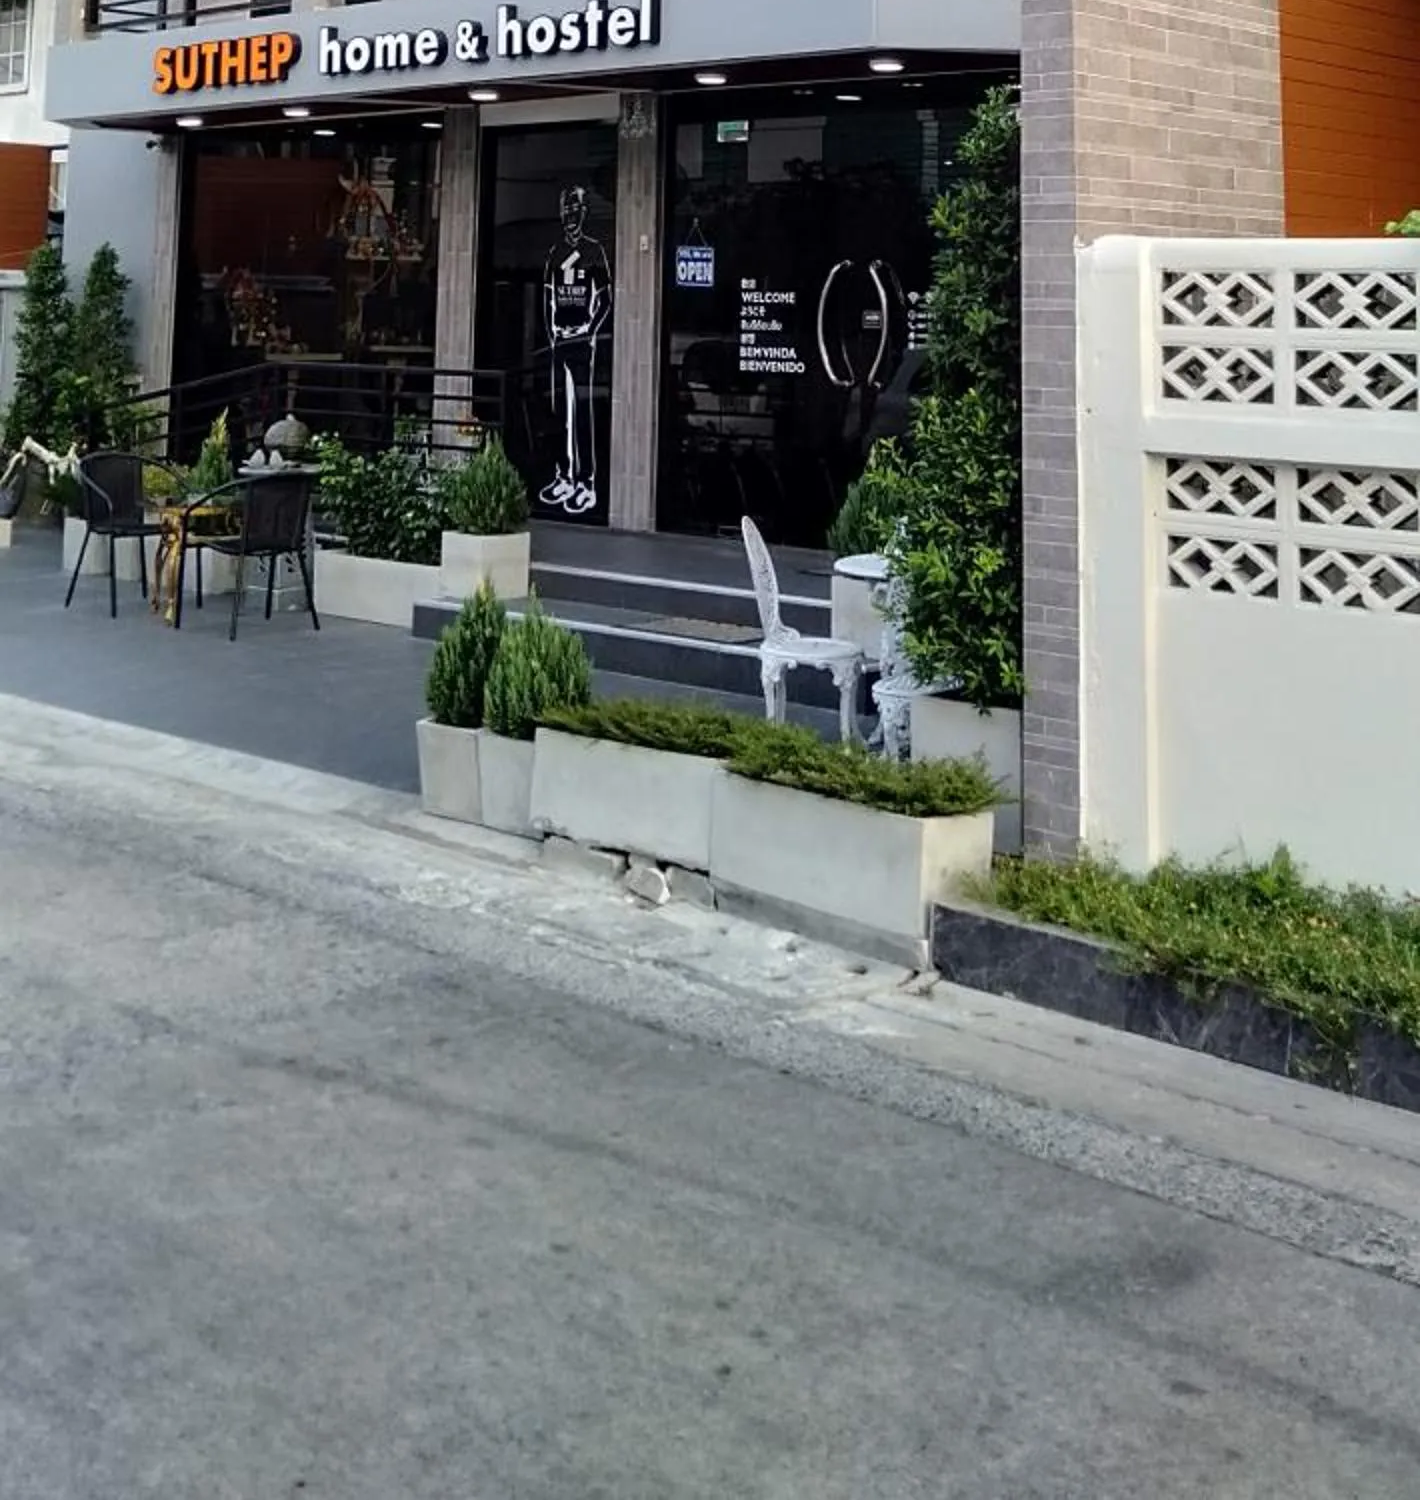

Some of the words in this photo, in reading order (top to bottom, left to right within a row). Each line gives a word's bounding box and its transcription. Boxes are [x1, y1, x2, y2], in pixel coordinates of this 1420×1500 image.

[153, 32, 297, 95] SUTHEP
[319, 26, 442, 75] home
[454, 19, 484, 61] &
[678, 260, 713, 281] OPEN
[741, 292, 796, 304] WELCOME
[740, 360, 806, 373] BIENVENIDO
